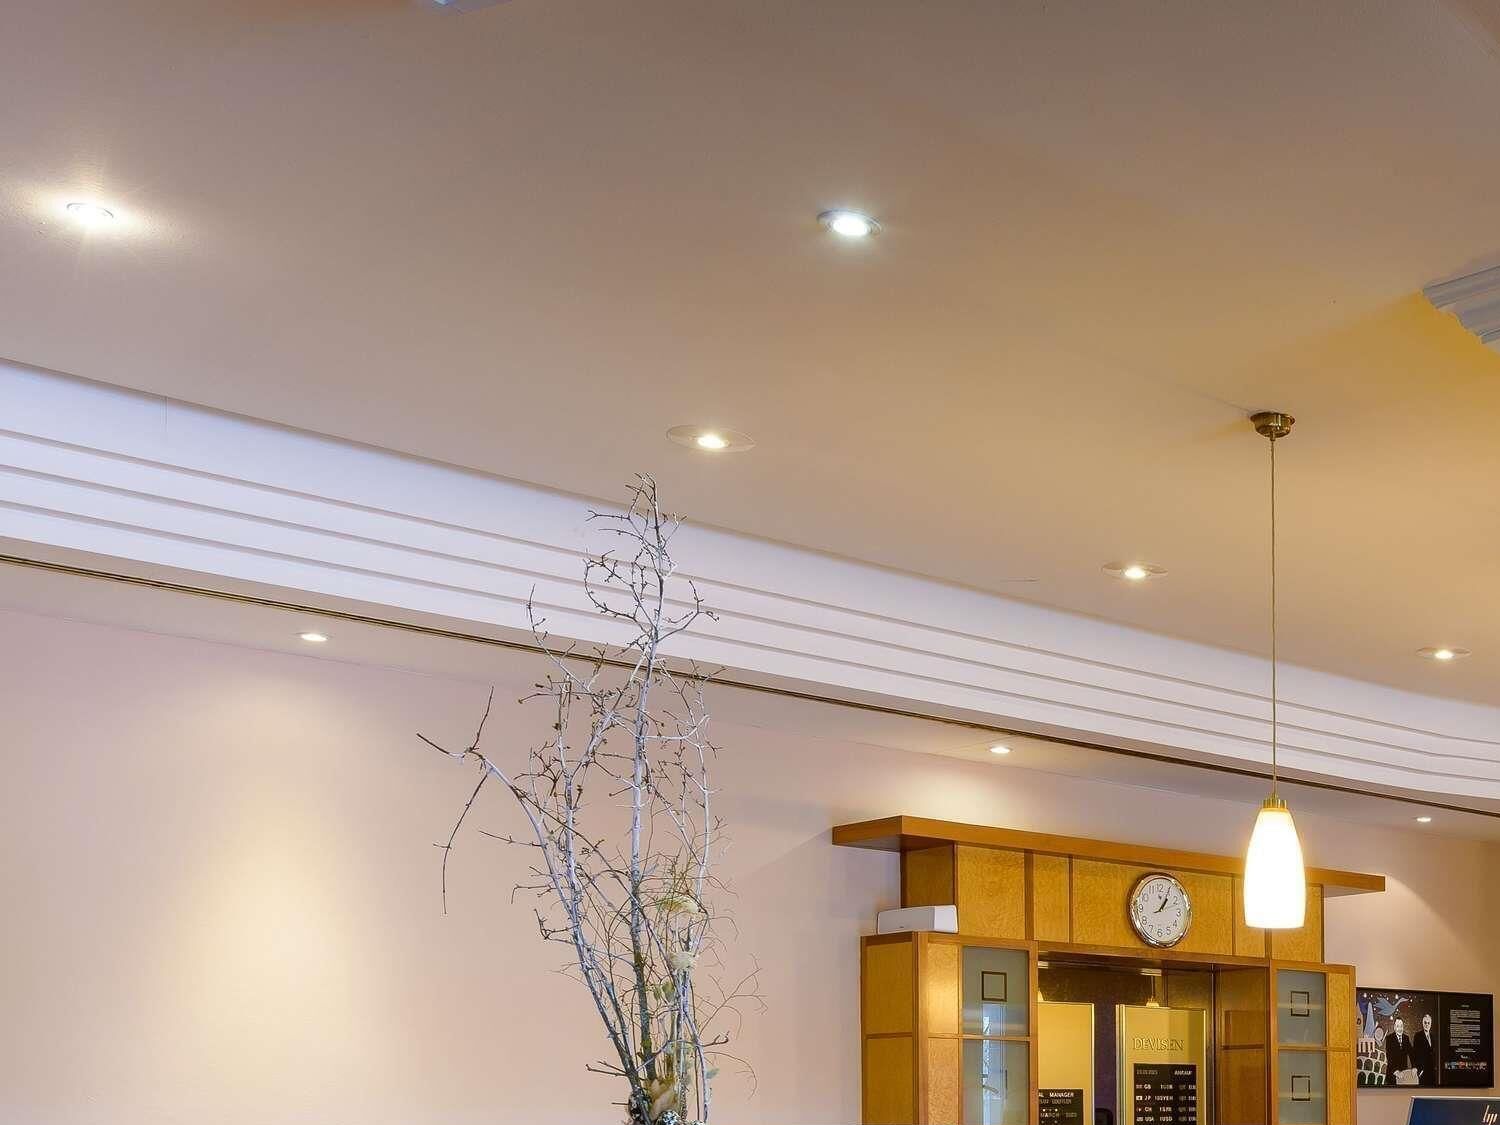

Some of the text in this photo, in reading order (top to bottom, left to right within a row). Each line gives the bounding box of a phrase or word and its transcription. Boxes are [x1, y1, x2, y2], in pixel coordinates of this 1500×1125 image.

[1156, 883, 1164, 893] 12
[1173, 896, 1178, 905] 2
[1138, 903, 1144, 912] 9
[1176, 908, 1181, 917] 3
[1142, 915, 1148, 925] 8
[1157, 928, 1163, 937] 6
[1133, 1038, 1184, 1051] DEVISEN
